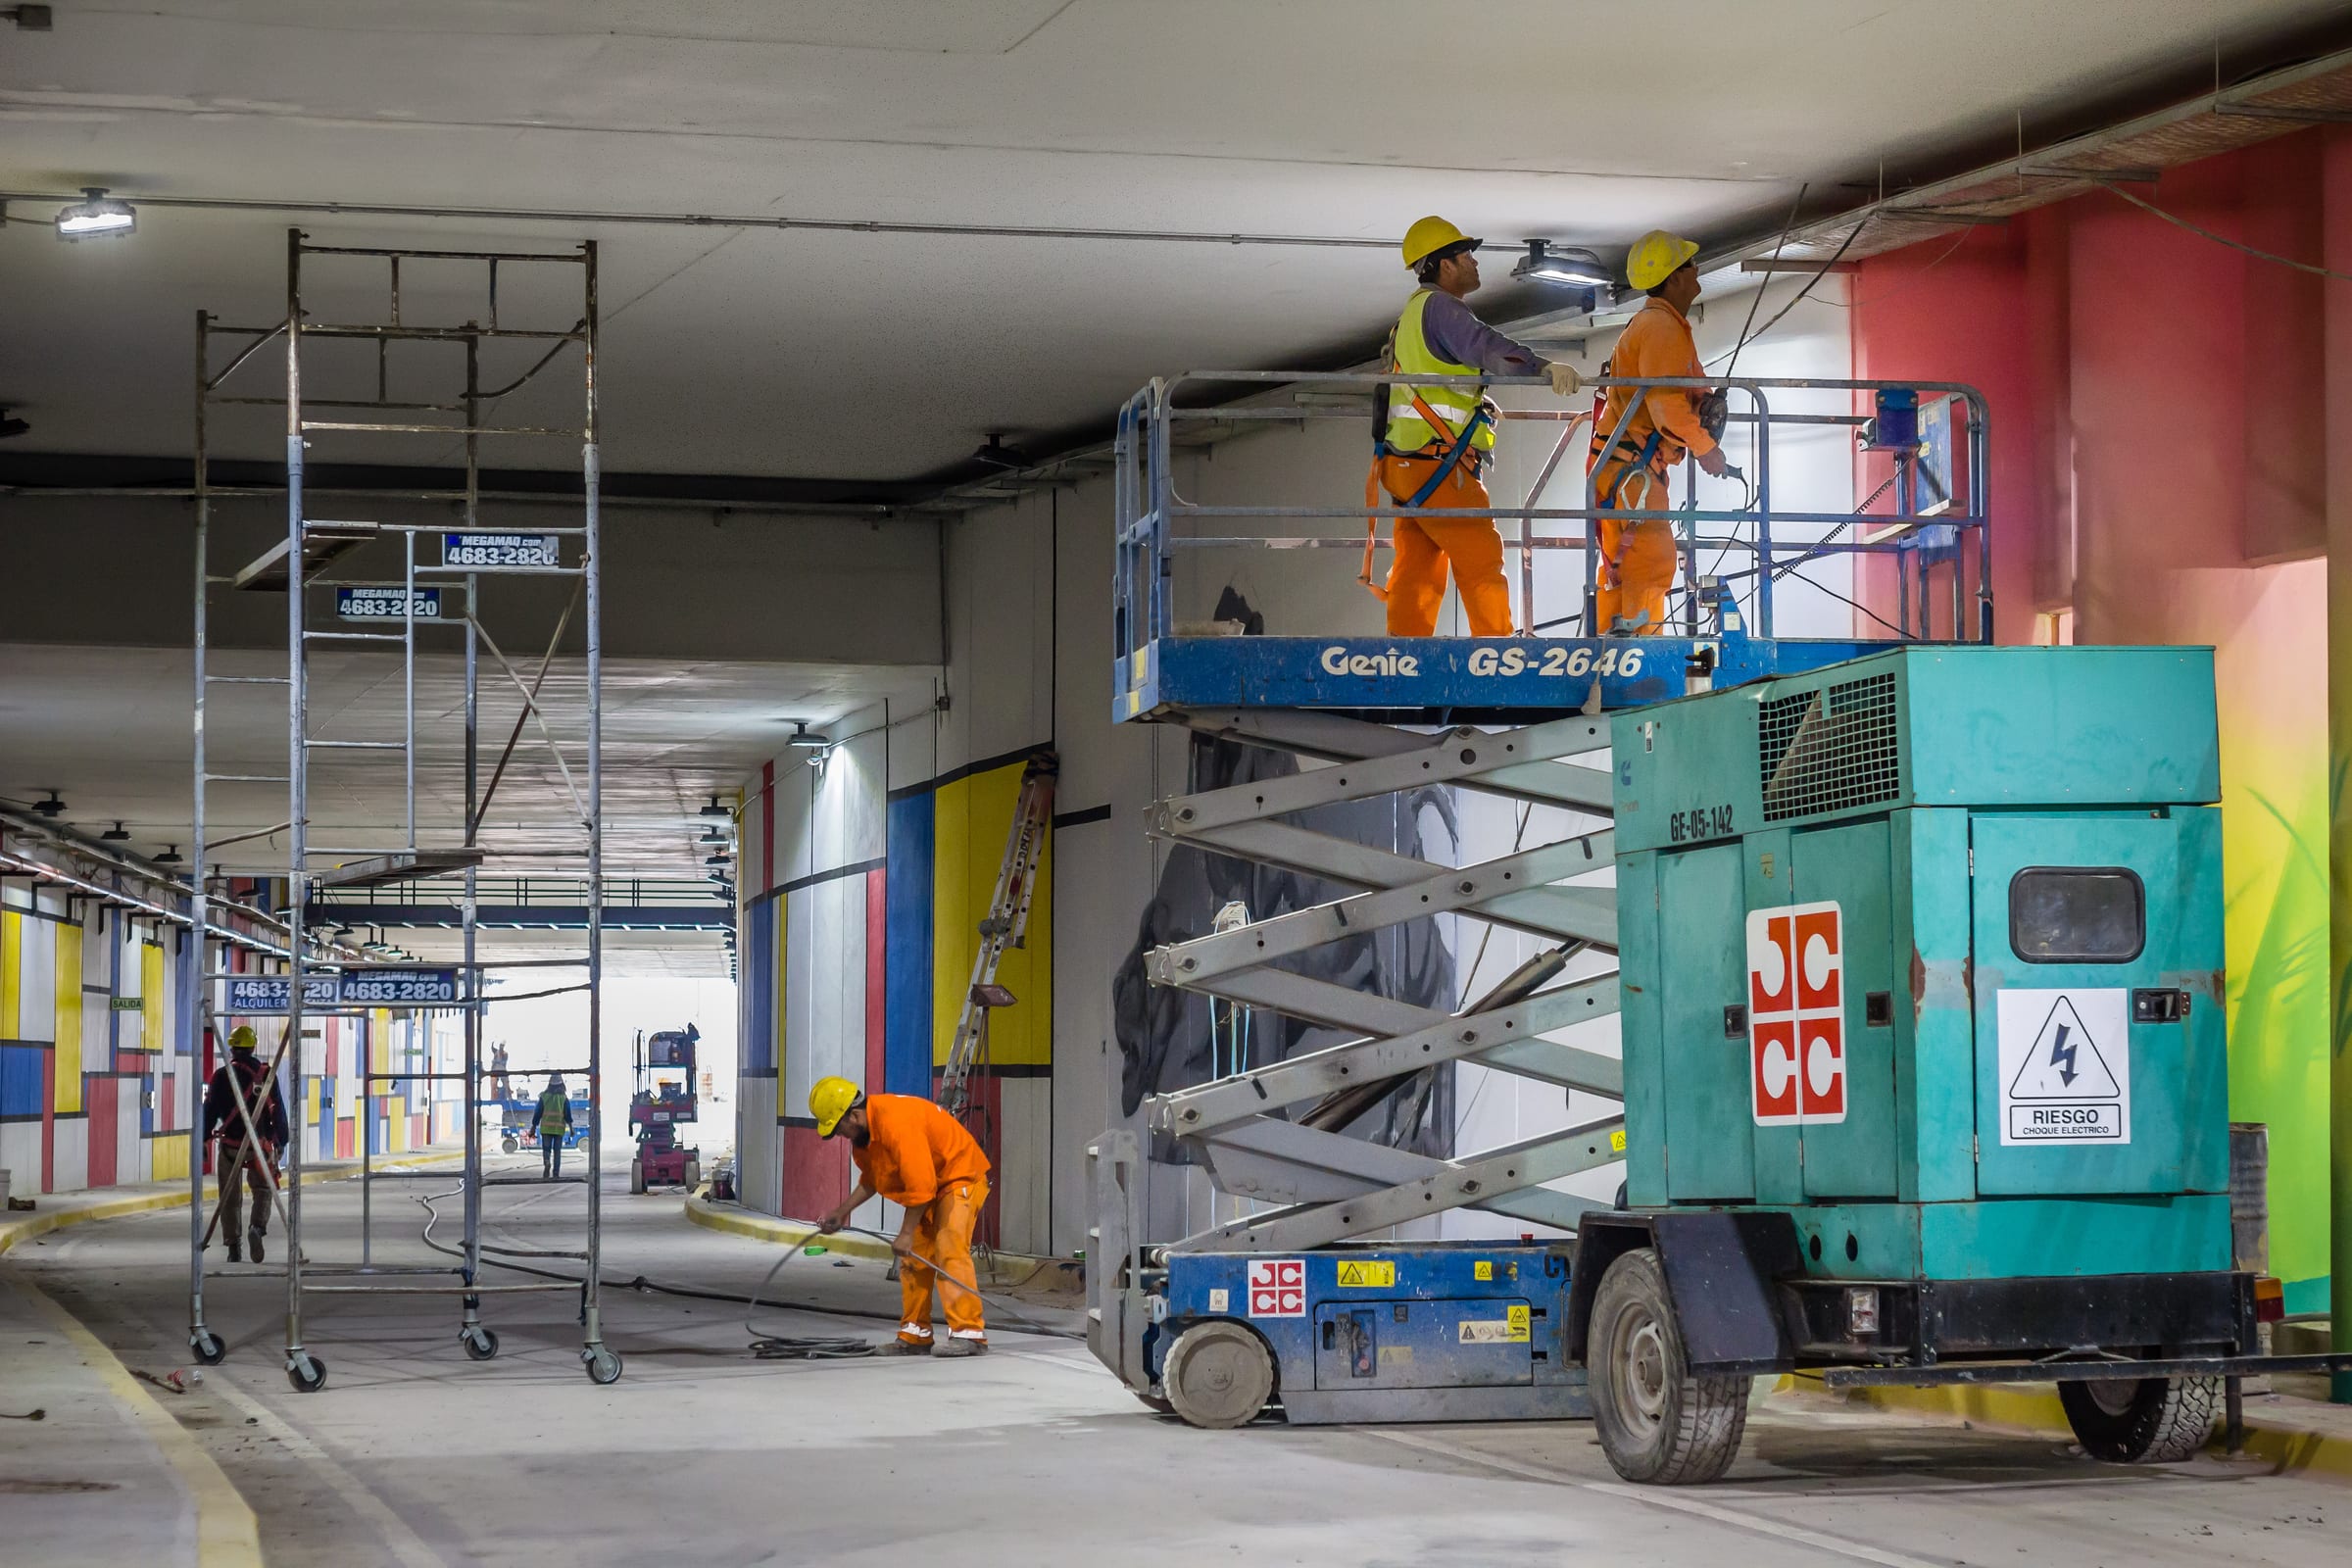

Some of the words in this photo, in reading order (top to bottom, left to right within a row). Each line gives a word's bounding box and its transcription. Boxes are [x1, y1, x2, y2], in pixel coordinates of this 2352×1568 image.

[1322, 647, 1420, 676] Genie
[1468, 647, 1643, 677] GS-2646
[1671, 805, 1734, 842] GE-05-142
[344, 983, 451, 1000] 4683-2820
[113, 1000, 142, 1008] SALIDA
[235, 999, 287, 1008] ALQUILER
[2033, 1109, 2099, 1124] RIESGO
[2061, 1126, 2110, 1135] ELECTRICO
